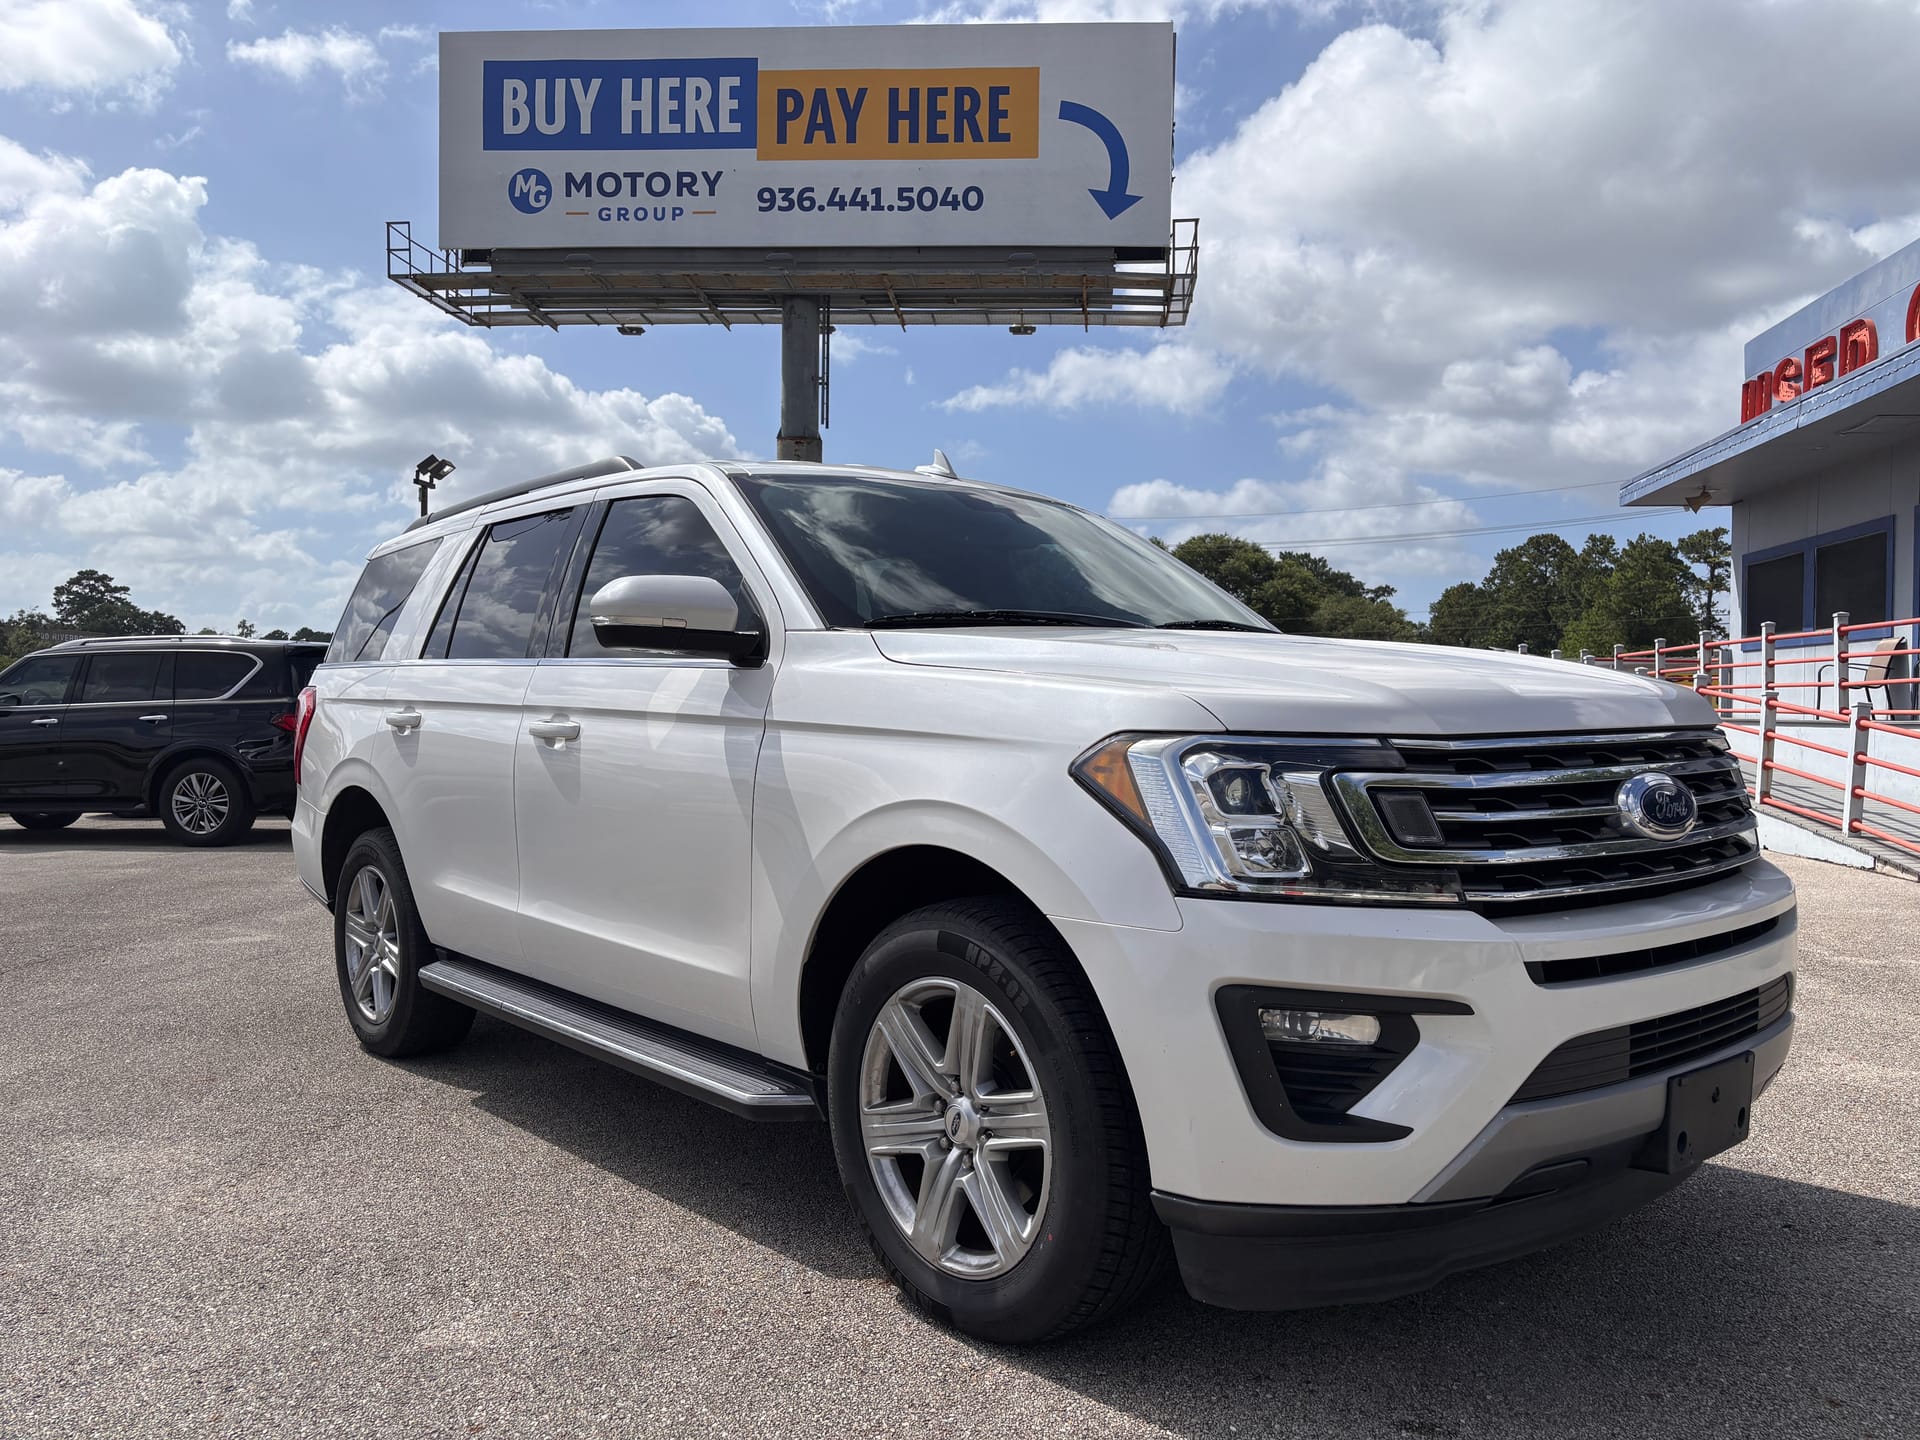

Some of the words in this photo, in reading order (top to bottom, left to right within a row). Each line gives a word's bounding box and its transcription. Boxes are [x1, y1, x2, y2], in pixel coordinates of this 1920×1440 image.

[503, 78, 603, 135] BUY
[621, 76, 742, 134] HERE
[776, 87, 869, 144] PAY
[887, 85, 1012, 144] HERE
[514, 174, 548, 208] MG
[564, 170, 724, 198] MOTORY
[756, 185, 985, 212] 936.441.5040
[597, 206, 685, 222] GROUP
[1741, 318, 1879, 425] USED
[1655, 790, 1689, 820] Ford
